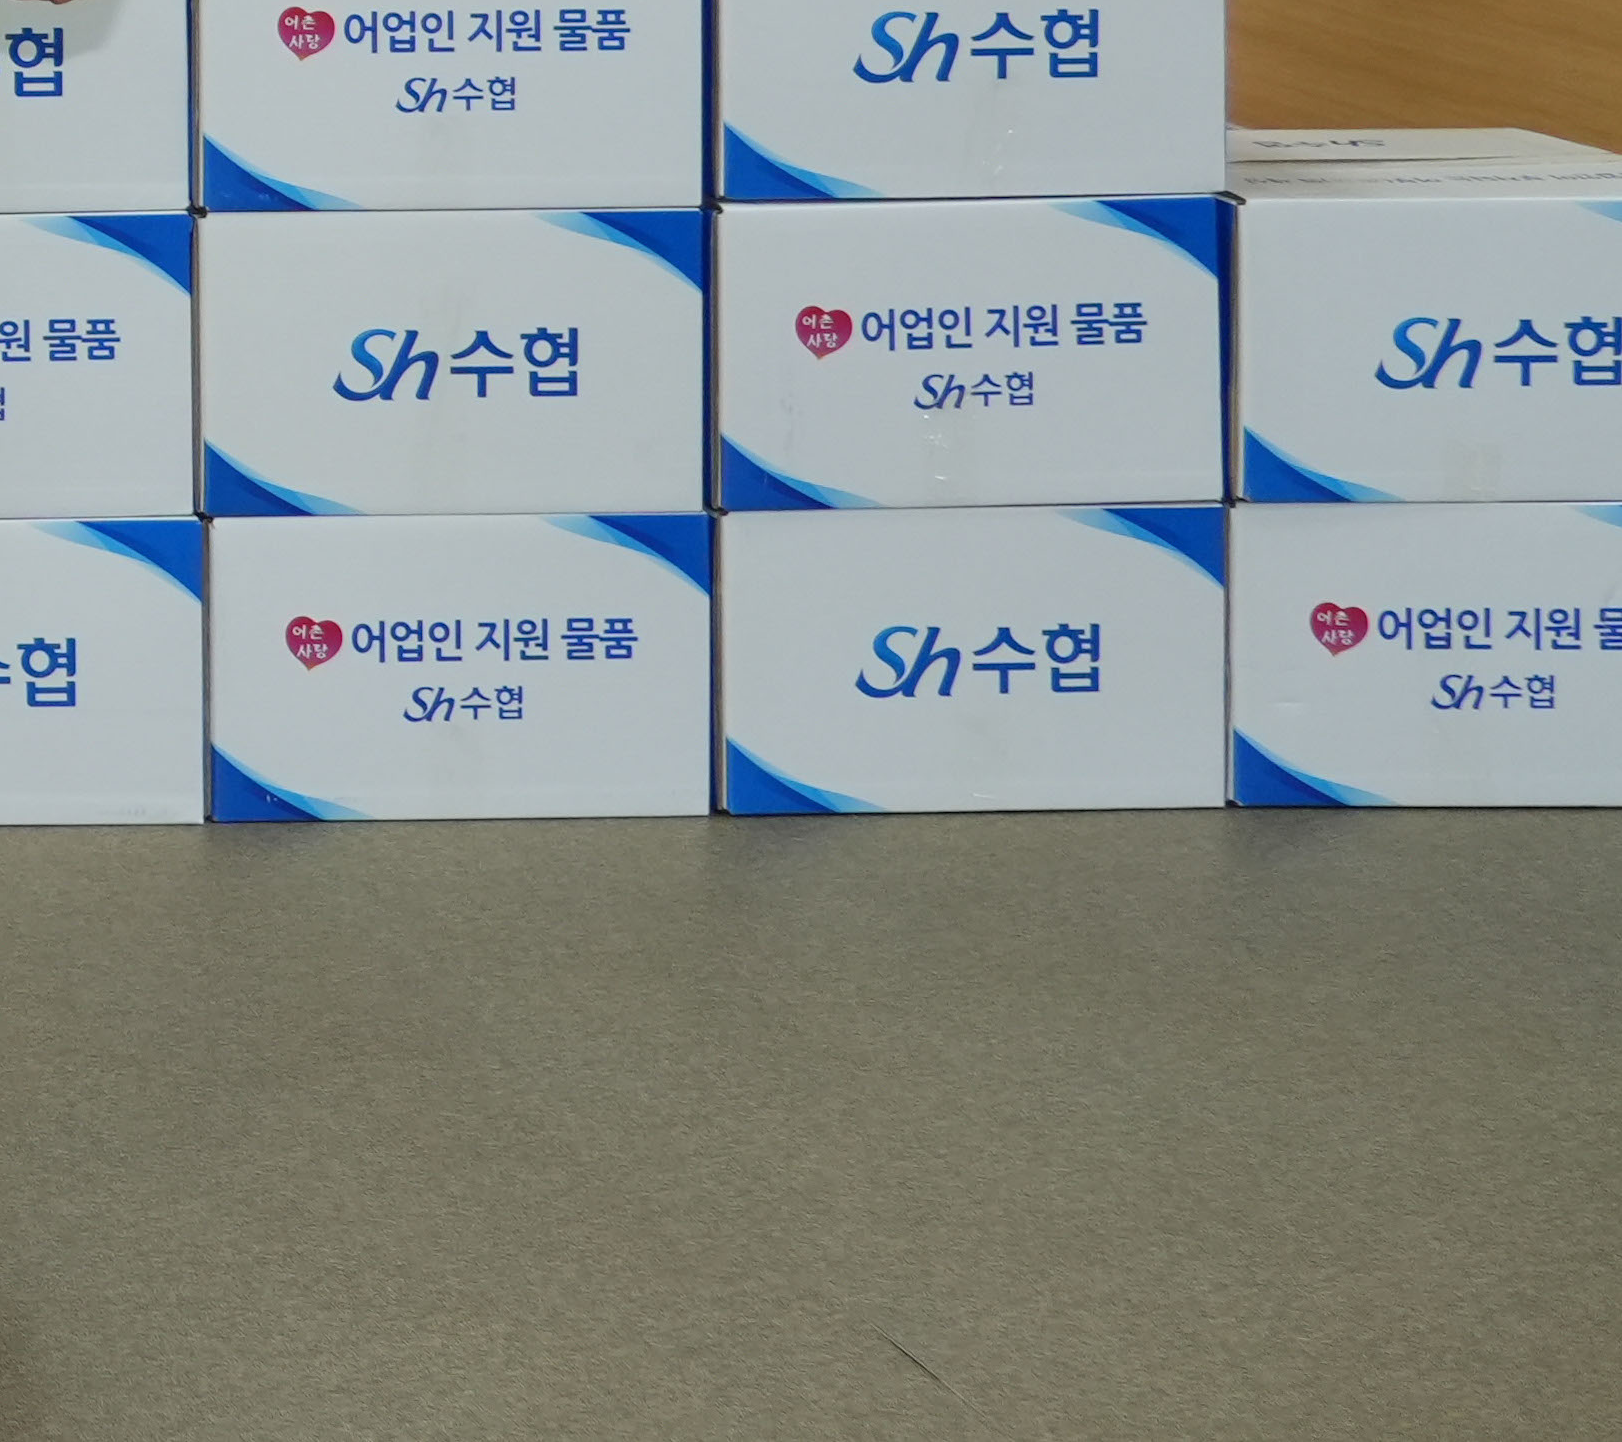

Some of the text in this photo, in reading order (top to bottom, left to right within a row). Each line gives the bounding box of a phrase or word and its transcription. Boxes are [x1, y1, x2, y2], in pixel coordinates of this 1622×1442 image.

[345, 8, 631, 54] 어업인 지원 물품
[854, 8, 1101, 85] Sh수협
[396, 77, 517, 114] Sh수협
[43, 317, 122, 363] 물품
[861, 302, 1148, 351] 어업인 지원 물품
[332, 327, 579, 402] Sh수협
[1376, 315, 1622, 390] Sh수협
[914, 373, 1034, 410] Sh수협
[351, 617, 640, 663] 어업인 지원 물품
[1378, 606, 1622, 651] 어업인 지원 물
[855, 623, 1102, 699] Sh수협
[403, 685, 525, 723] Sh수협
[1431, 674, 1556, 710] Sh수협
